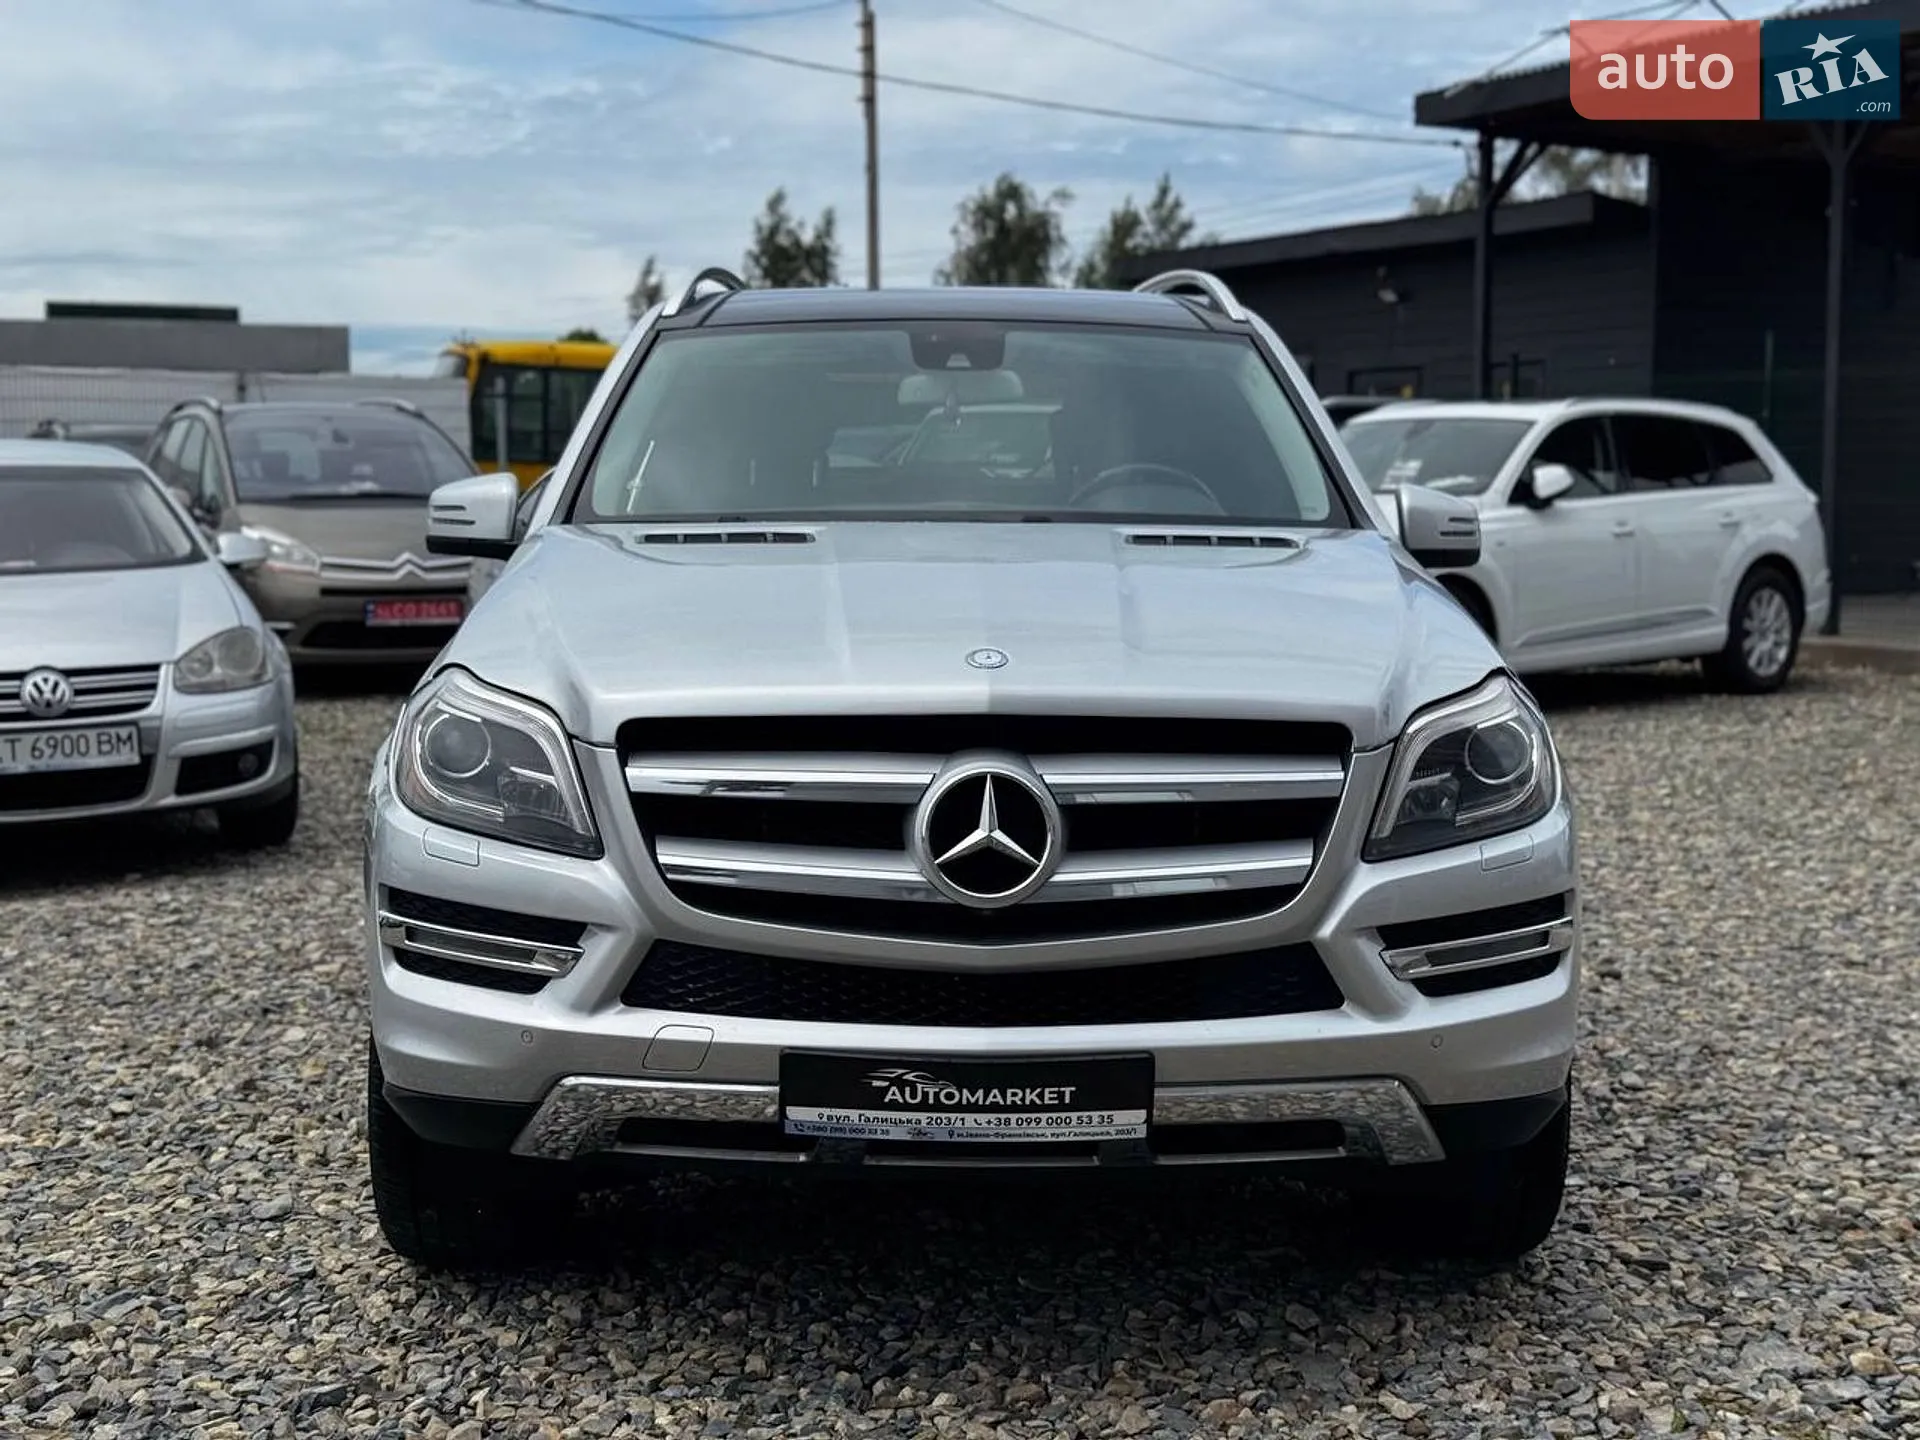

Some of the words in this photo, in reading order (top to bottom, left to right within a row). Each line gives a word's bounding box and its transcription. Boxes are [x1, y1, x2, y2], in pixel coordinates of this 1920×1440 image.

[0, 738, 22, 763] T
[30, 733, 90, 760] 6900
[96, 731, 135, 755] BM
[884, 1085, 1077, 1105] AUTOMARKET
[826, 1114, 854, 1125] вул.
[858, 1112, 922, 1127] Галицька
[926, 1115, 966, 1127] 203/1
[986, 1116, 1012, 1127] +38
[1015, 1116, 1043, 1127] 099
[1046, 1115, 1073, 1127] 000
[1076, 1114, 1093, 1126] 53
[1097, 1113, 1115, 1125] 35
